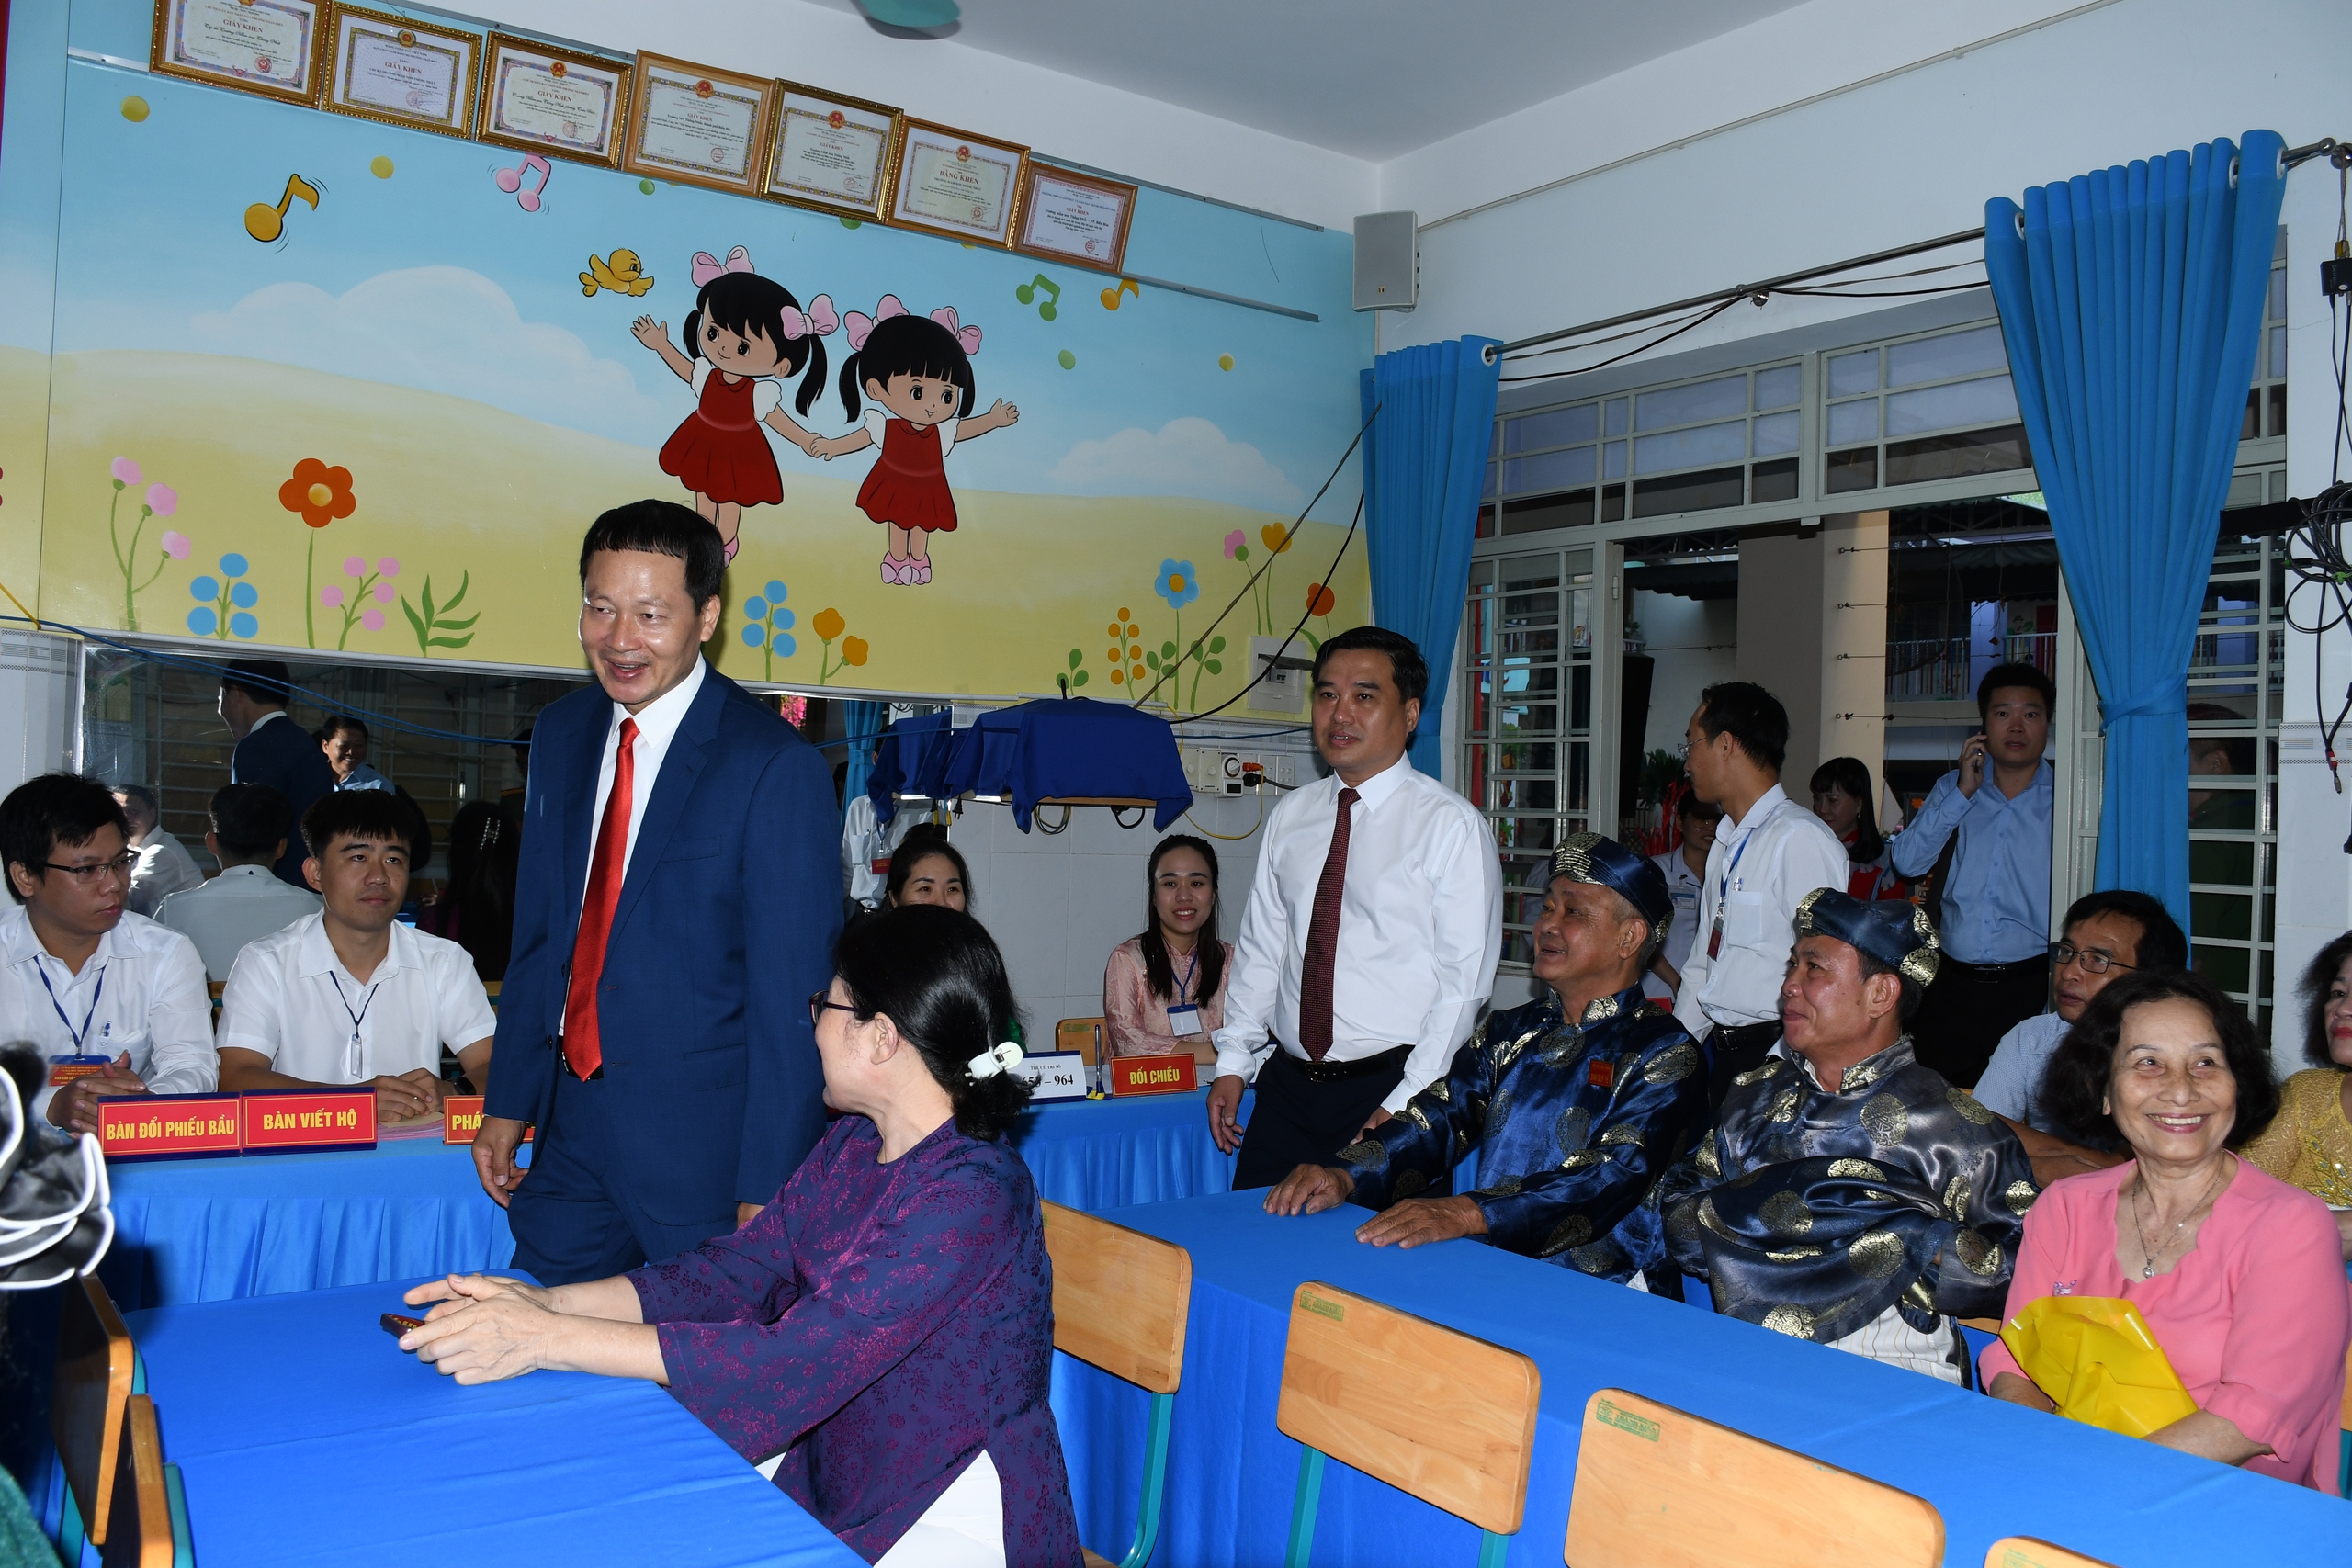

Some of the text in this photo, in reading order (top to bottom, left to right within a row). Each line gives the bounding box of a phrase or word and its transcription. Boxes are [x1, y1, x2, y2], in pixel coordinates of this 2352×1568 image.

[223, 18, 264, 33] GIẤY KHEN
[385, 61, 422, 74] GIẤY KHEN
[554, 94, 571, 102] KHEN
[940, 168, 958, 179] BẰNG
[959, 175, 978, 184] KHEN
[1054, 1074, 1073, 1086] 964
[1129, 1066, 1180, 1085] ĐỐI CHIẾU
[263, 1107, 357, 1130] BÀN VIẾT HỘ
[451, 1111, 484, 1131] PHÁ
[107, 1114, 235, 1140] BÀN ĐỔI PHIẾU BẦU
